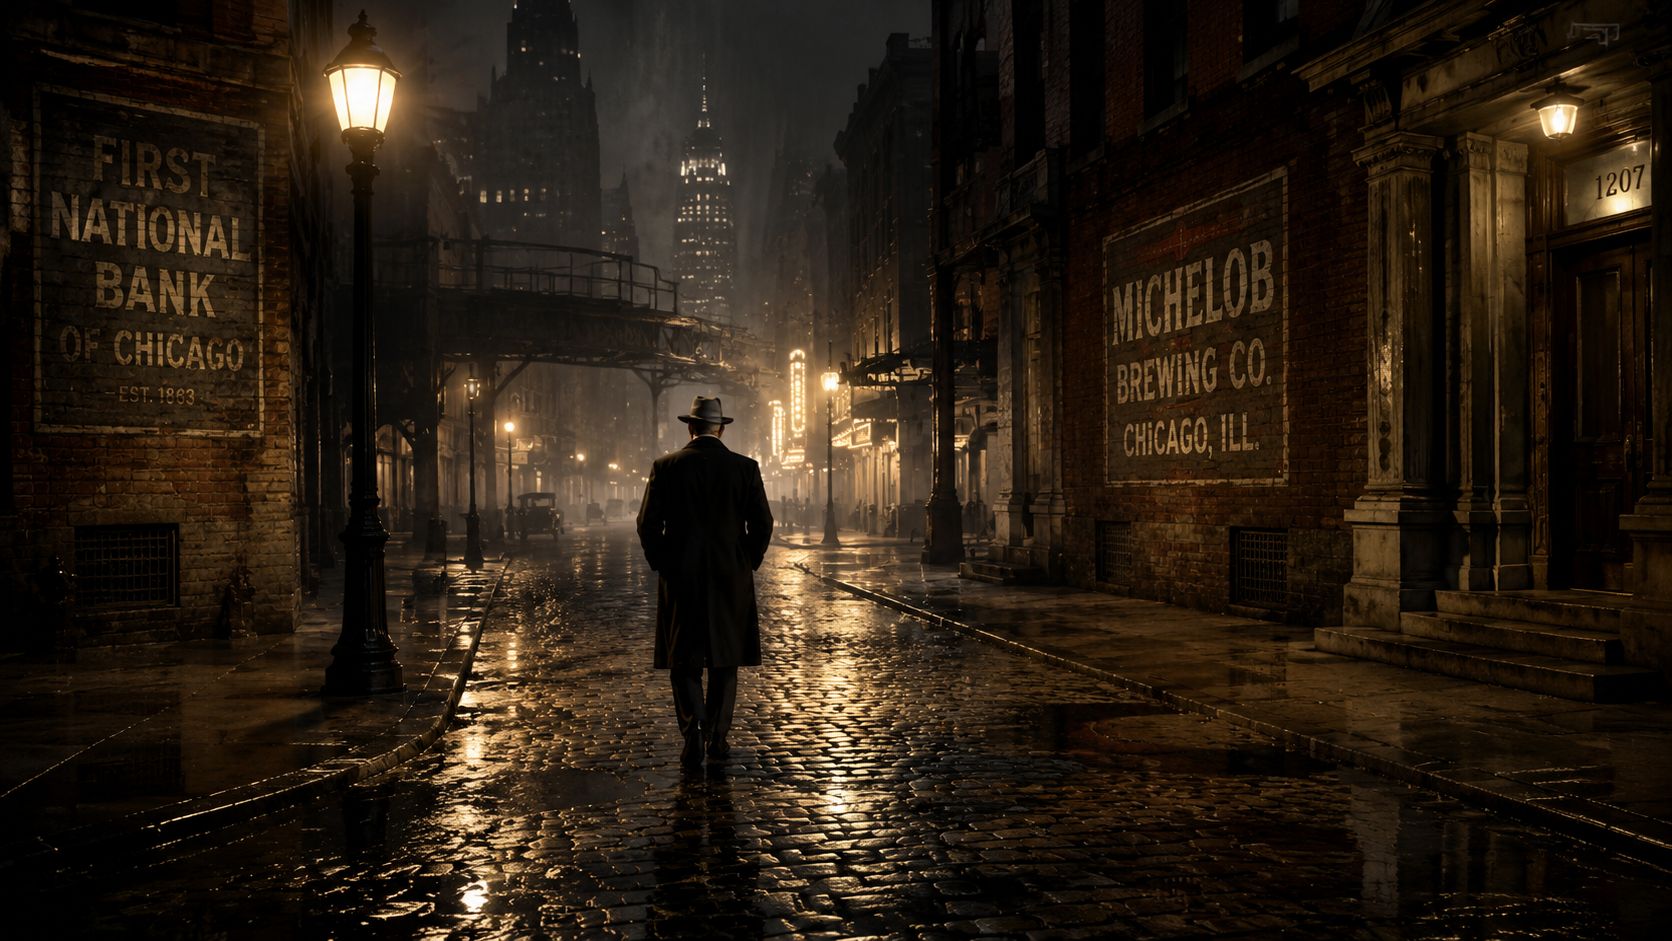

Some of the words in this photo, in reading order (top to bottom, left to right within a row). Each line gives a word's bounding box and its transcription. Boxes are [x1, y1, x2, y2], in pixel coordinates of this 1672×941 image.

[94, 135, 216, 197] FIRST
[1596, 165, 1645, 200] 1207
[50, 191, 251, 261] NATIONAL
[95, 261, 216, 318] BANK
[1112, 239, 1275, 346] MICHELOB
[59, 325, 101, 361] OF
[113, 329, 244, 372] CHICAGO
[1117, 347, 1218, 404] BREWING
[1230, 338, 1272, 390] CO.
[119, 385, 153, 404] EST.
[158, 386, 196, 406] 1863
[1124, 416, 1213, 459] CHICAGO,
[1221, 411, 1260, 452] ILL.
